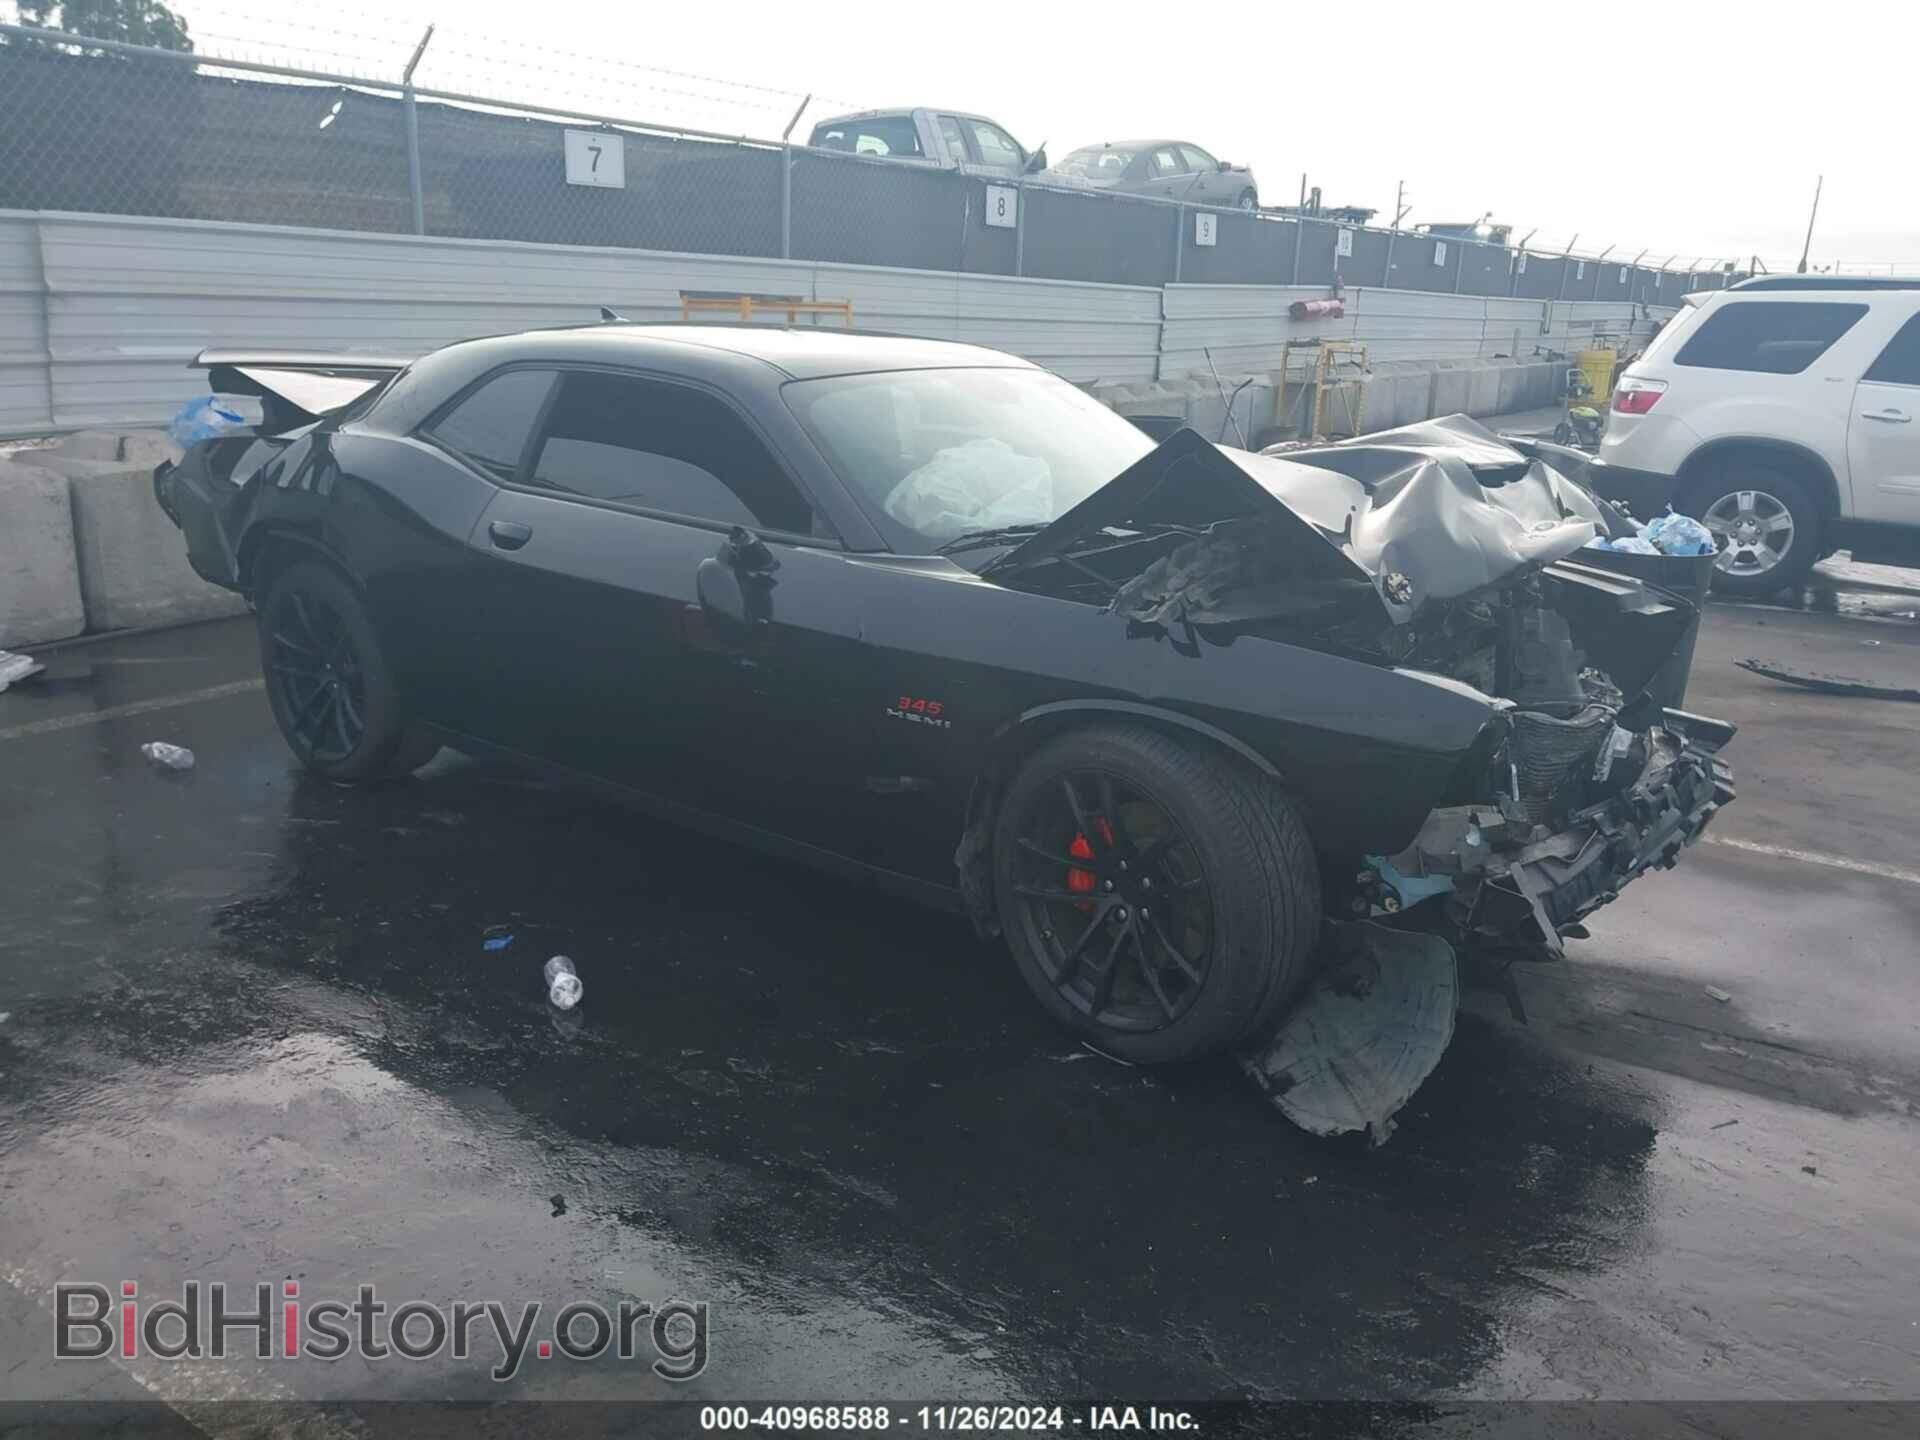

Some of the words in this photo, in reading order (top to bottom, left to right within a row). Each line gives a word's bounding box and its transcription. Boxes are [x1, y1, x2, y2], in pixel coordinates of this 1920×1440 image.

[588, 146, 602, 172] 7
[998, 197, 1005, 216] 8
[1203, 221, 1209, 237] 9
[898, 696, 944, 714] 345
